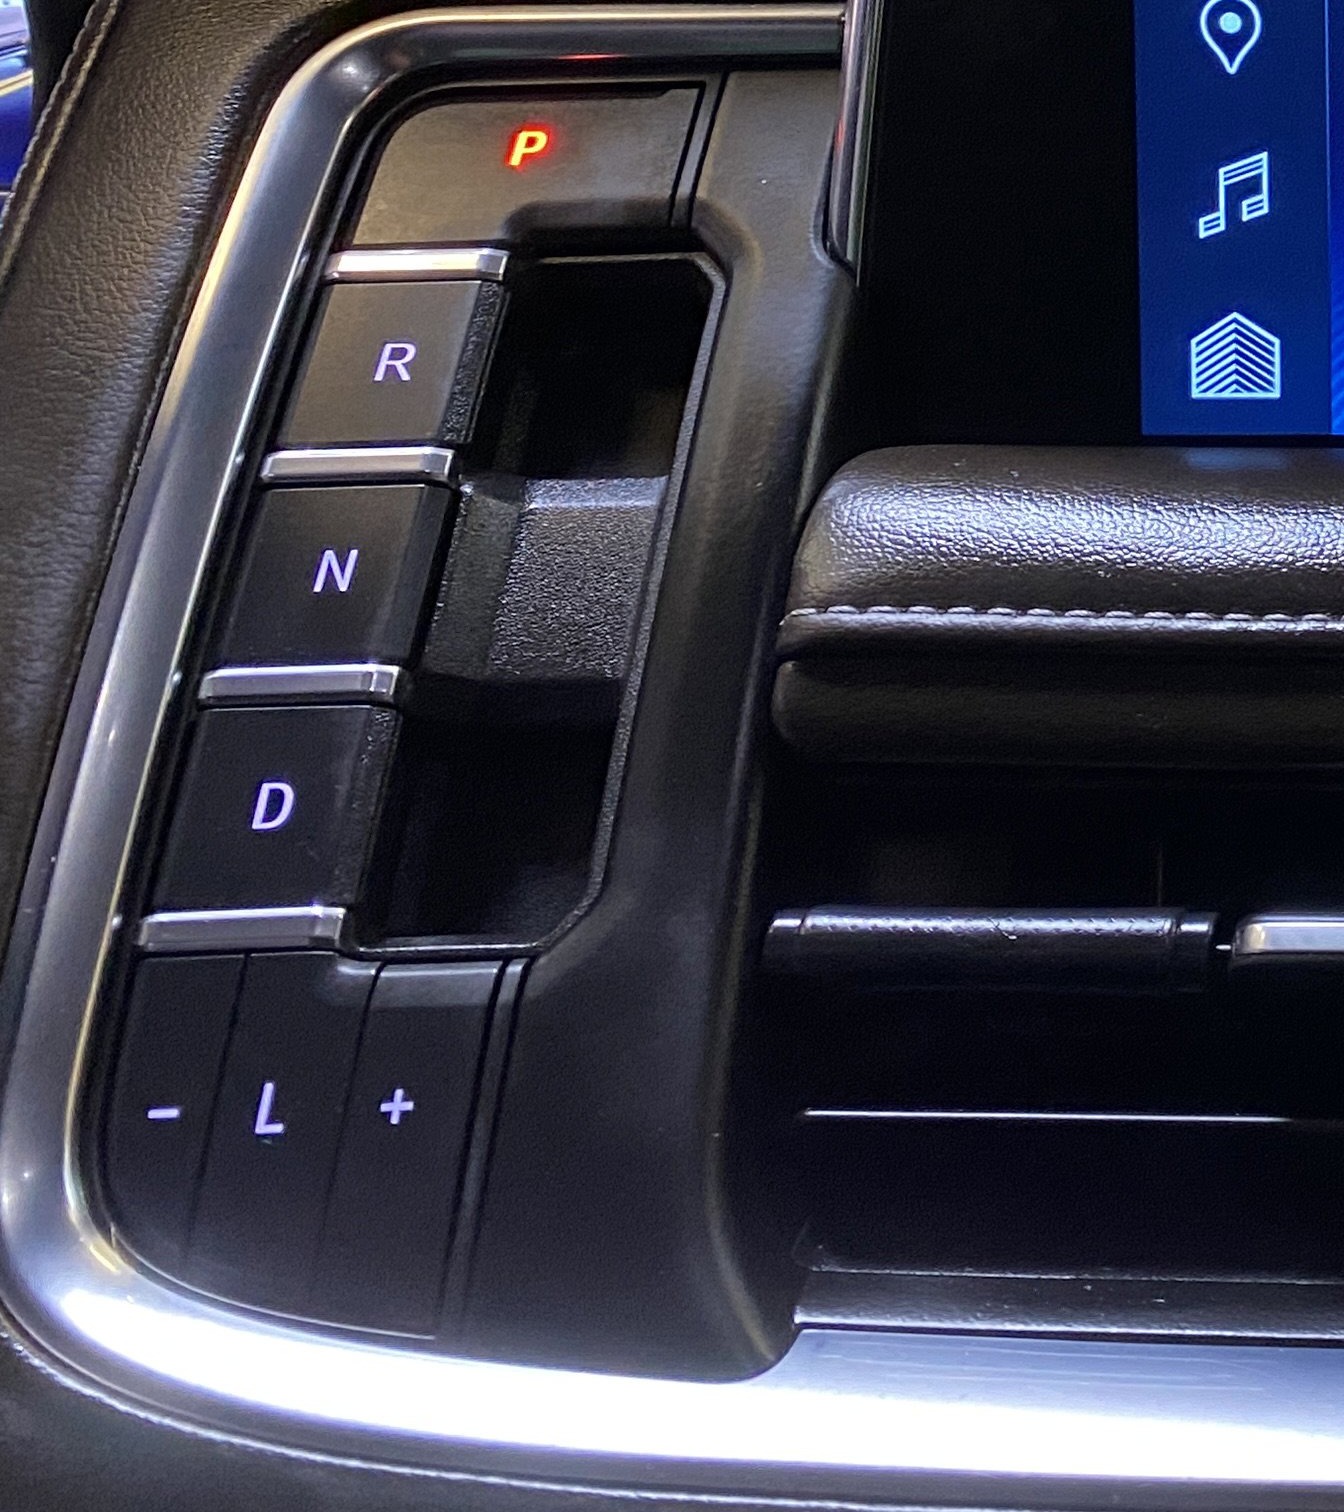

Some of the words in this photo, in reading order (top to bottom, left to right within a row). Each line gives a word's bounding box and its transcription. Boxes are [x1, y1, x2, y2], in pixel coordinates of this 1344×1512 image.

[508, 129, 549, 168] P
[373, 343, 416, 382] R
[312, 549, 359, 593] N
[251, 782, 295, 830] D
[254, 1082, 285, 1135] L
